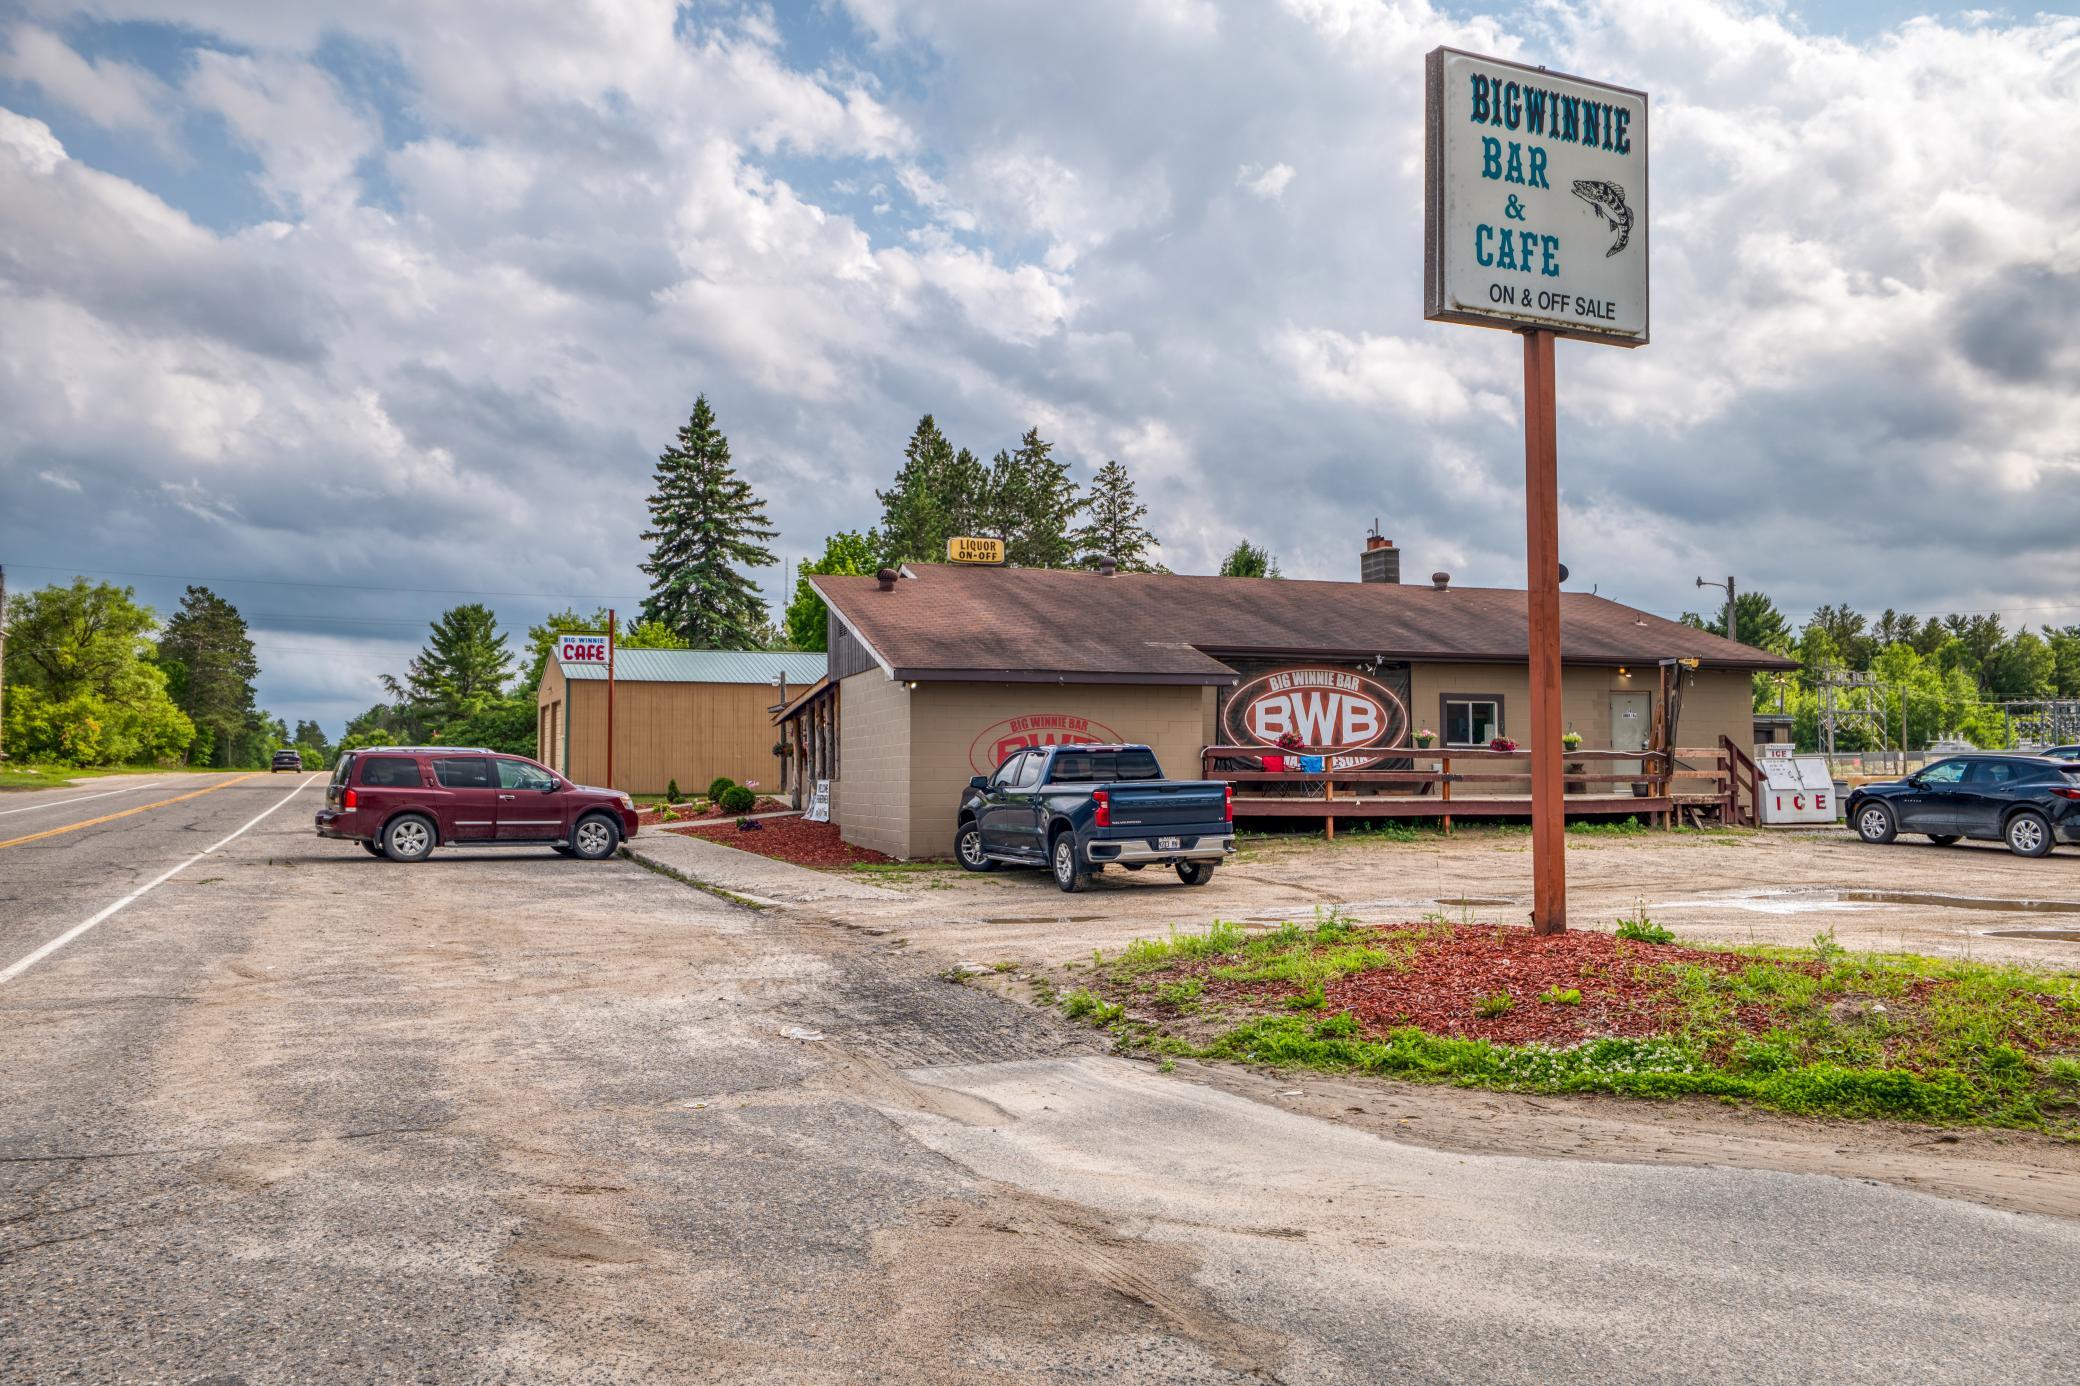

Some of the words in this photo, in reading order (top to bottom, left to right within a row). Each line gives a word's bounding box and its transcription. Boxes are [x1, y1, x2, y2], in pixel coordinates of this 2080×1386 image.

[1482, 136, 1549, 190] BAR
[1504, 194, 1526, 221] &
[1475, 223, 1559, 277] CAFE
[1489, 283, 1514, 304] ON
[1521, 288, 1532, 308] &
[1538, 291, 1570, 312] OFF
[1575, 296, 1616, 320] SALE
[959, 551, 997, 560] ON-OFF
[960, 540, 996, 551] LIQUOR
[563, 644, 605, 660] CAFE
[1269, 673, 1291, 691] BIG
[1292, 671, 1334, 686] WINNIE
[1336, 672, 1359, 691] BAR
[1010, 718, 1029, 732] BIG
[1030, 716, 1066, 728] WINNIE
[1068, 718, 1088, 731] BAR
[1255, 691, 1379, 746] BWB
[1776, 794, 1827, 810] ICE
